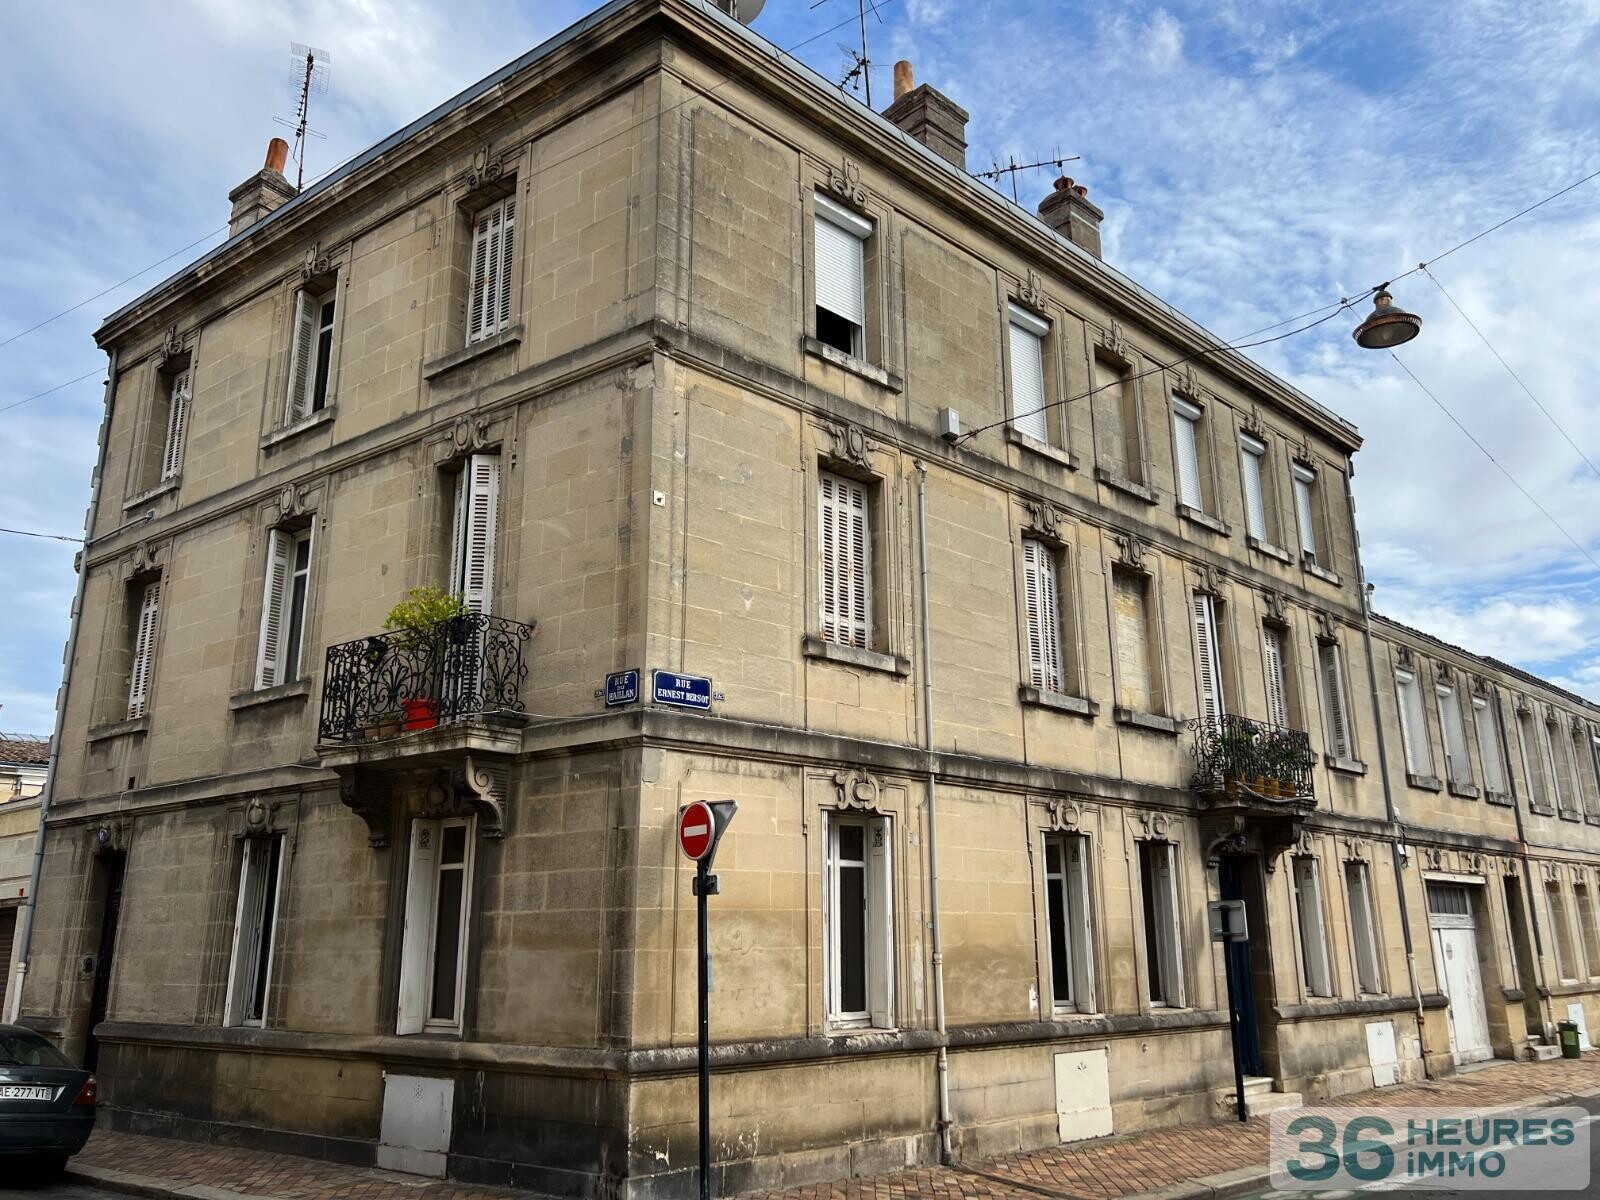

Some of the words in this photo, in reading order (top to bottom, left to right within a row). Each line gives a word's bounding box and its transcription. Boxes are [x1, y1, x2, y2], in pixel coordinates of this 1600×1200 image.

[614, 675, 629, 686] RUE
[675, 678, 691, 689] RUE
[608, 688, 635, 701] HAILLAN
[657, 688, 685, 700] ERNEST
[685, 692, 709, 704] BERSOT
